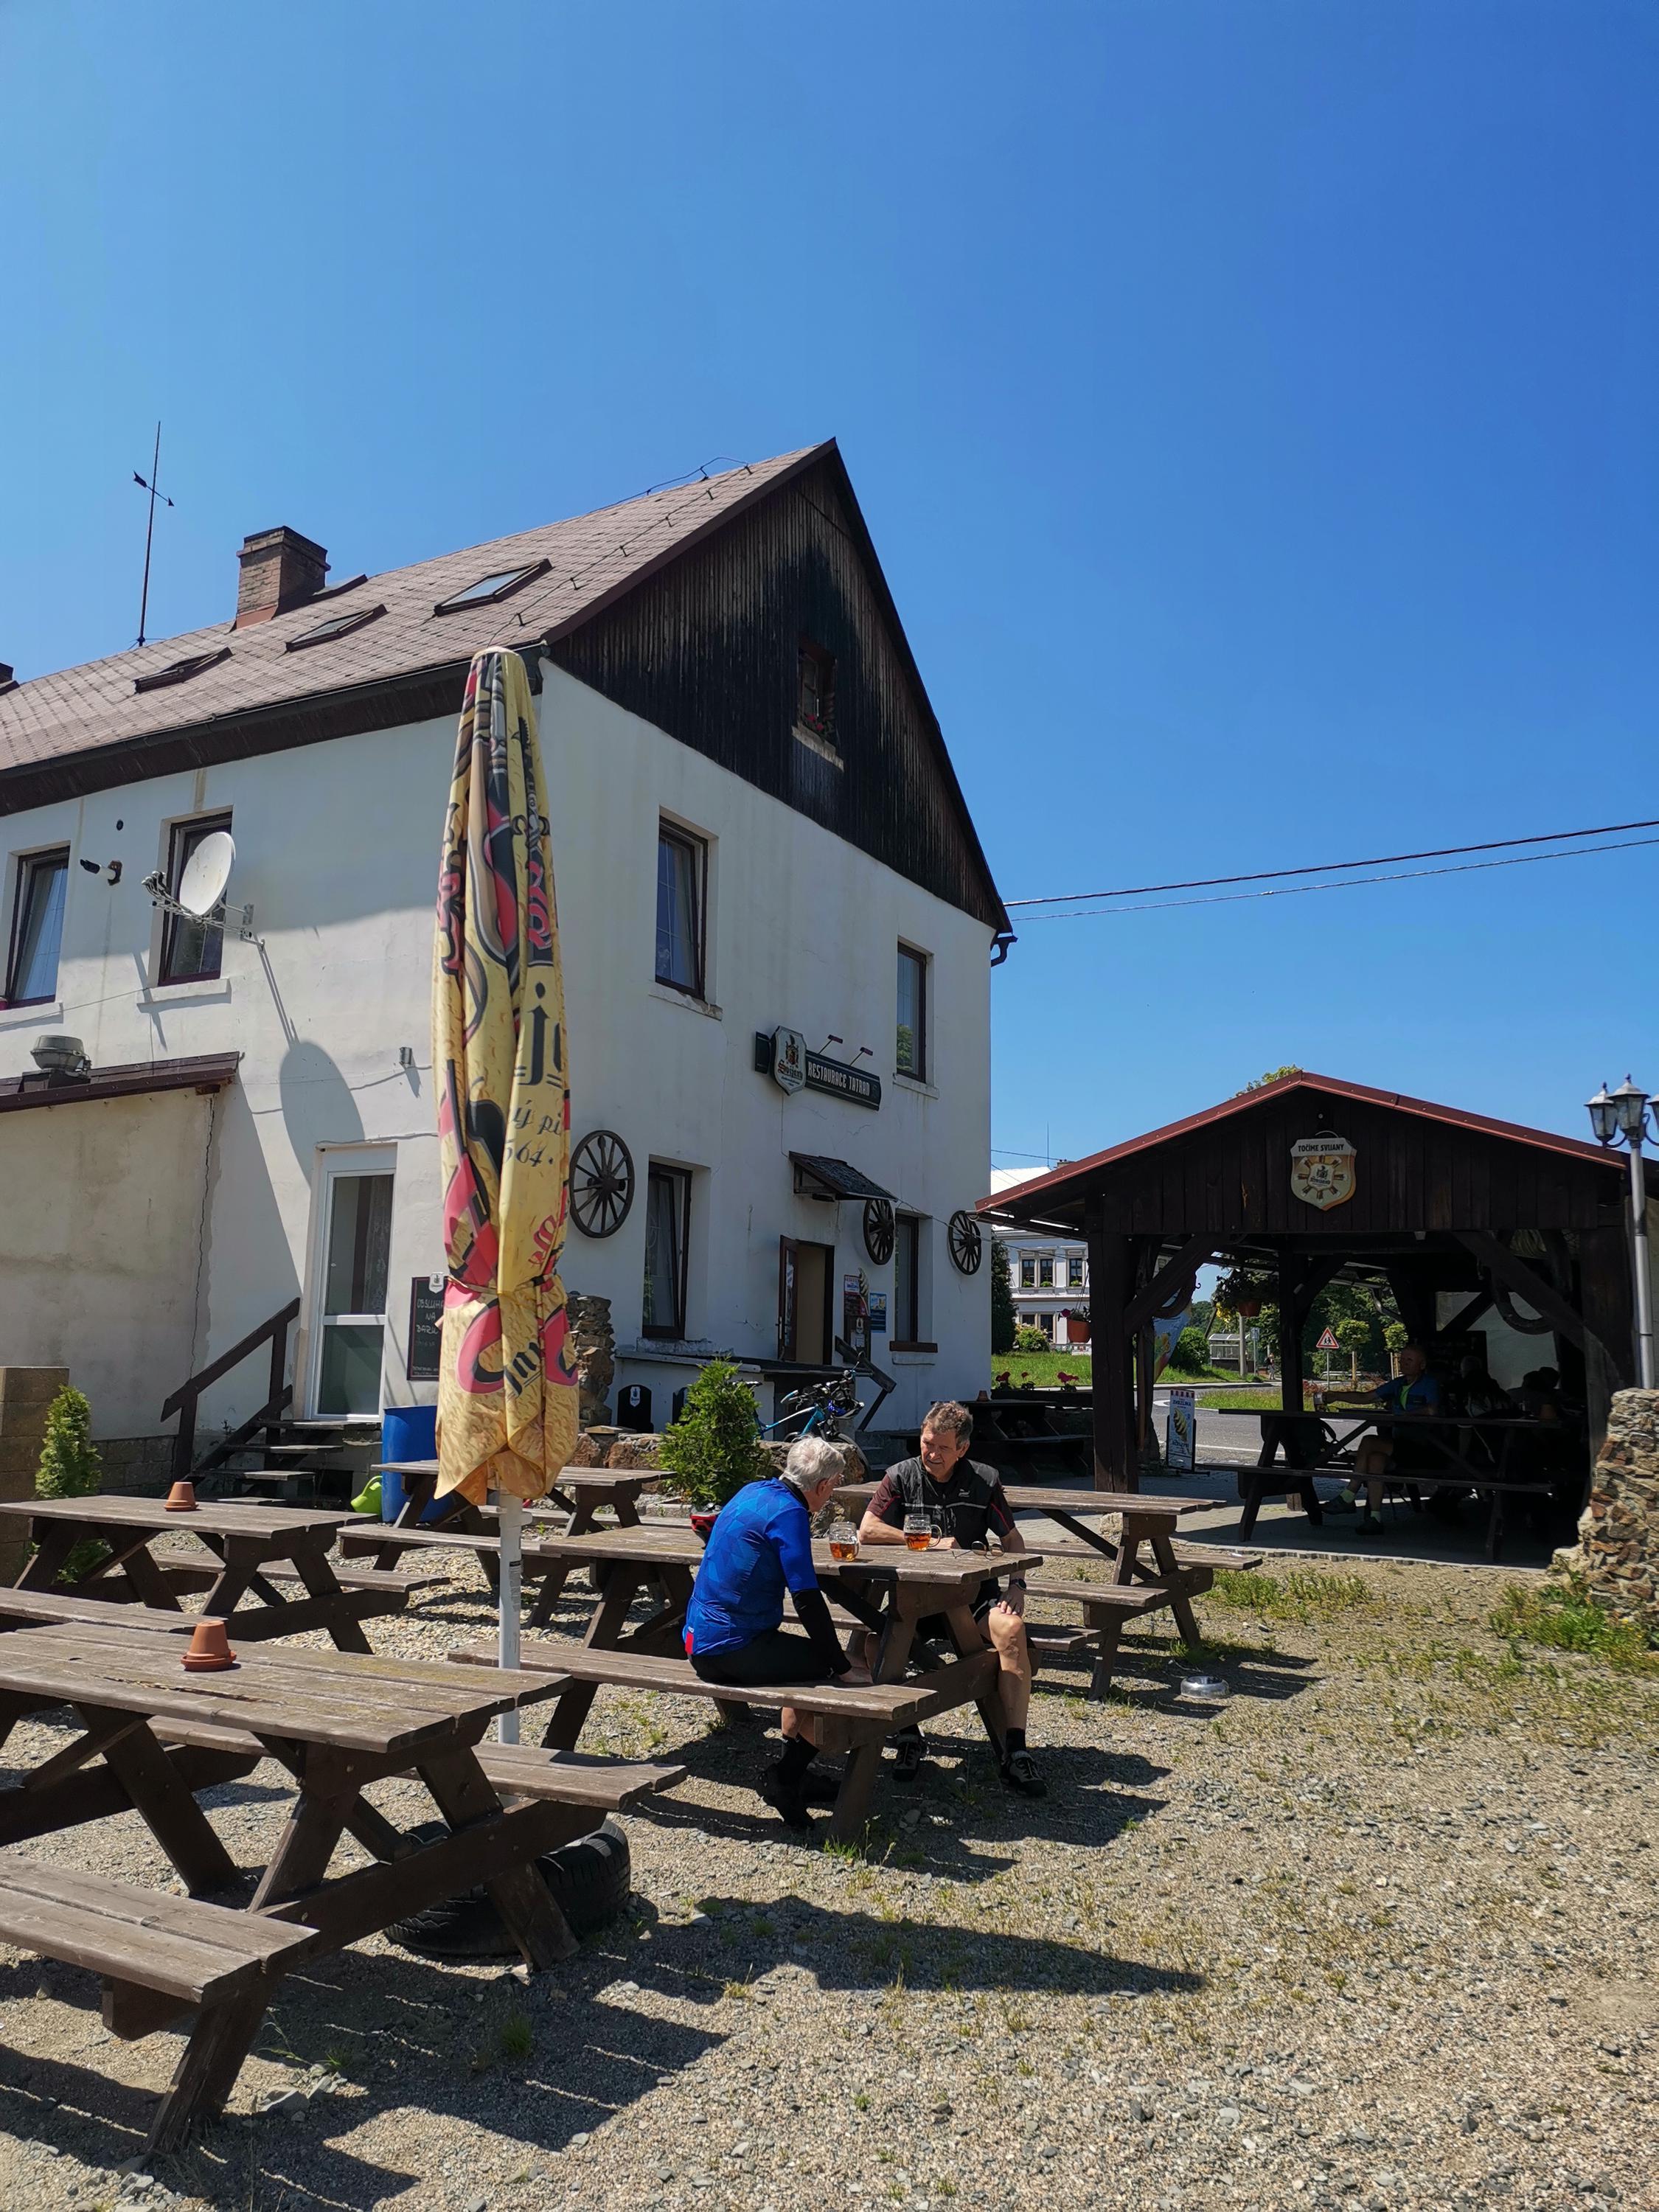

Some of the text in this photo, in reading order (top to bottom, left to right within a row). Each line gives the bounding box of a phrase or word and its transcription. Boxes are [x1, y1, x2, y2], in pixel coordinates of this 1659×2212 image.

[807, 1061, 846, 1089] RESTAURACE
[1298, 1144, 1344, 1152] TOČÍME SVIJANY
[425, 1312, 436, 1321] NA
